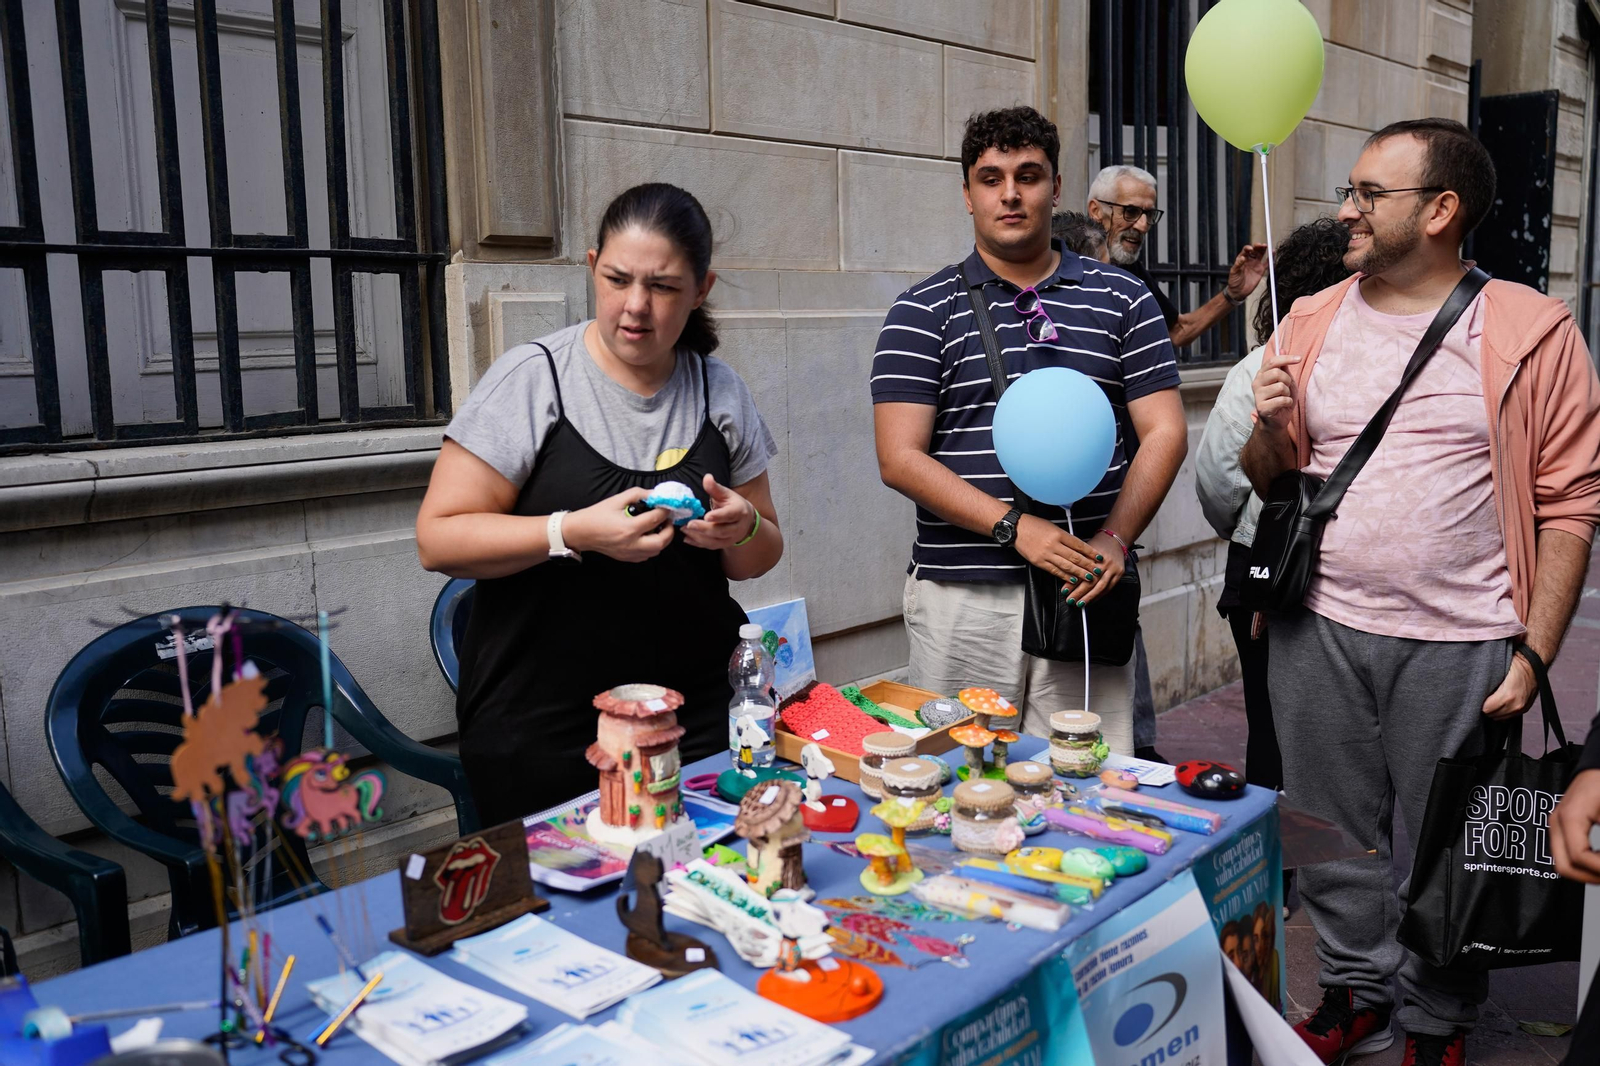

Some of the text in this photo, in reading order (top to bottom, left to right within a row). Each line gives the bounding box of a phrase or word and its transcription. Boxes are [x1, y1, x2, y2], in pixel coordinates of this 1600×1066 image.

[1249, 566, 1270, 579] FILA
[1465, 821, 1556, 866] FOR L
